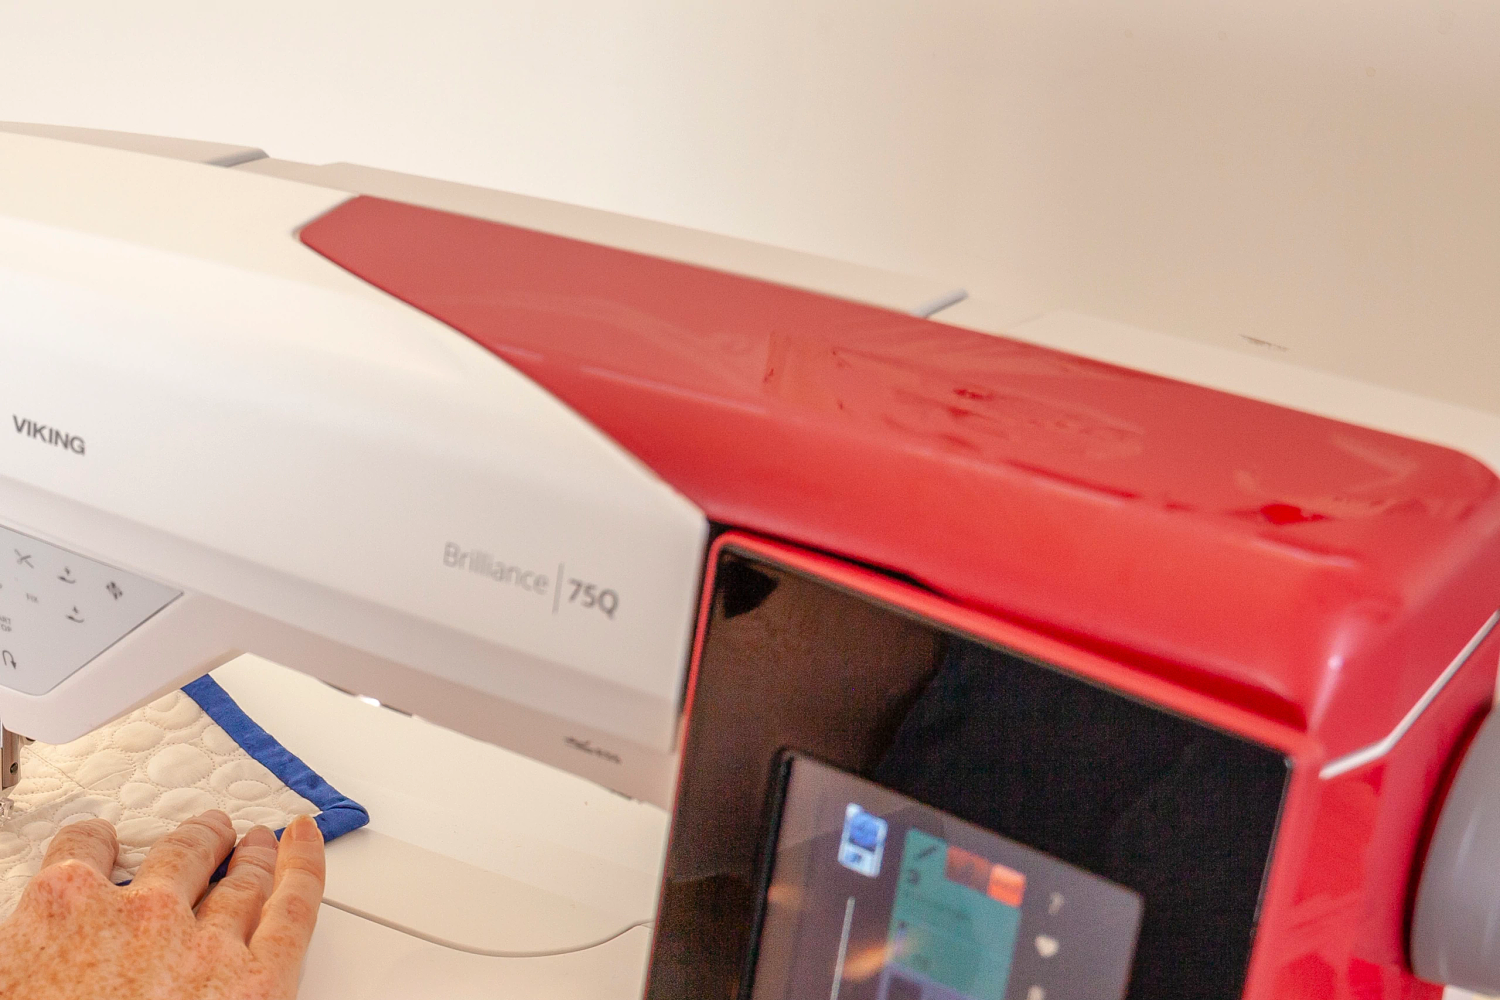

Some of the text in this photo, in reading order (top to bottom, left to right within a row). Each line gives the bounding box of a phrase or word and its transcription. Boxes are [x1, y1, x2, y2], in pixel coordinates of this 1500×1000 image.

[13, 414, 86, 456] VIKING
[443, 541, 620, 621] Brilliance 75Q
